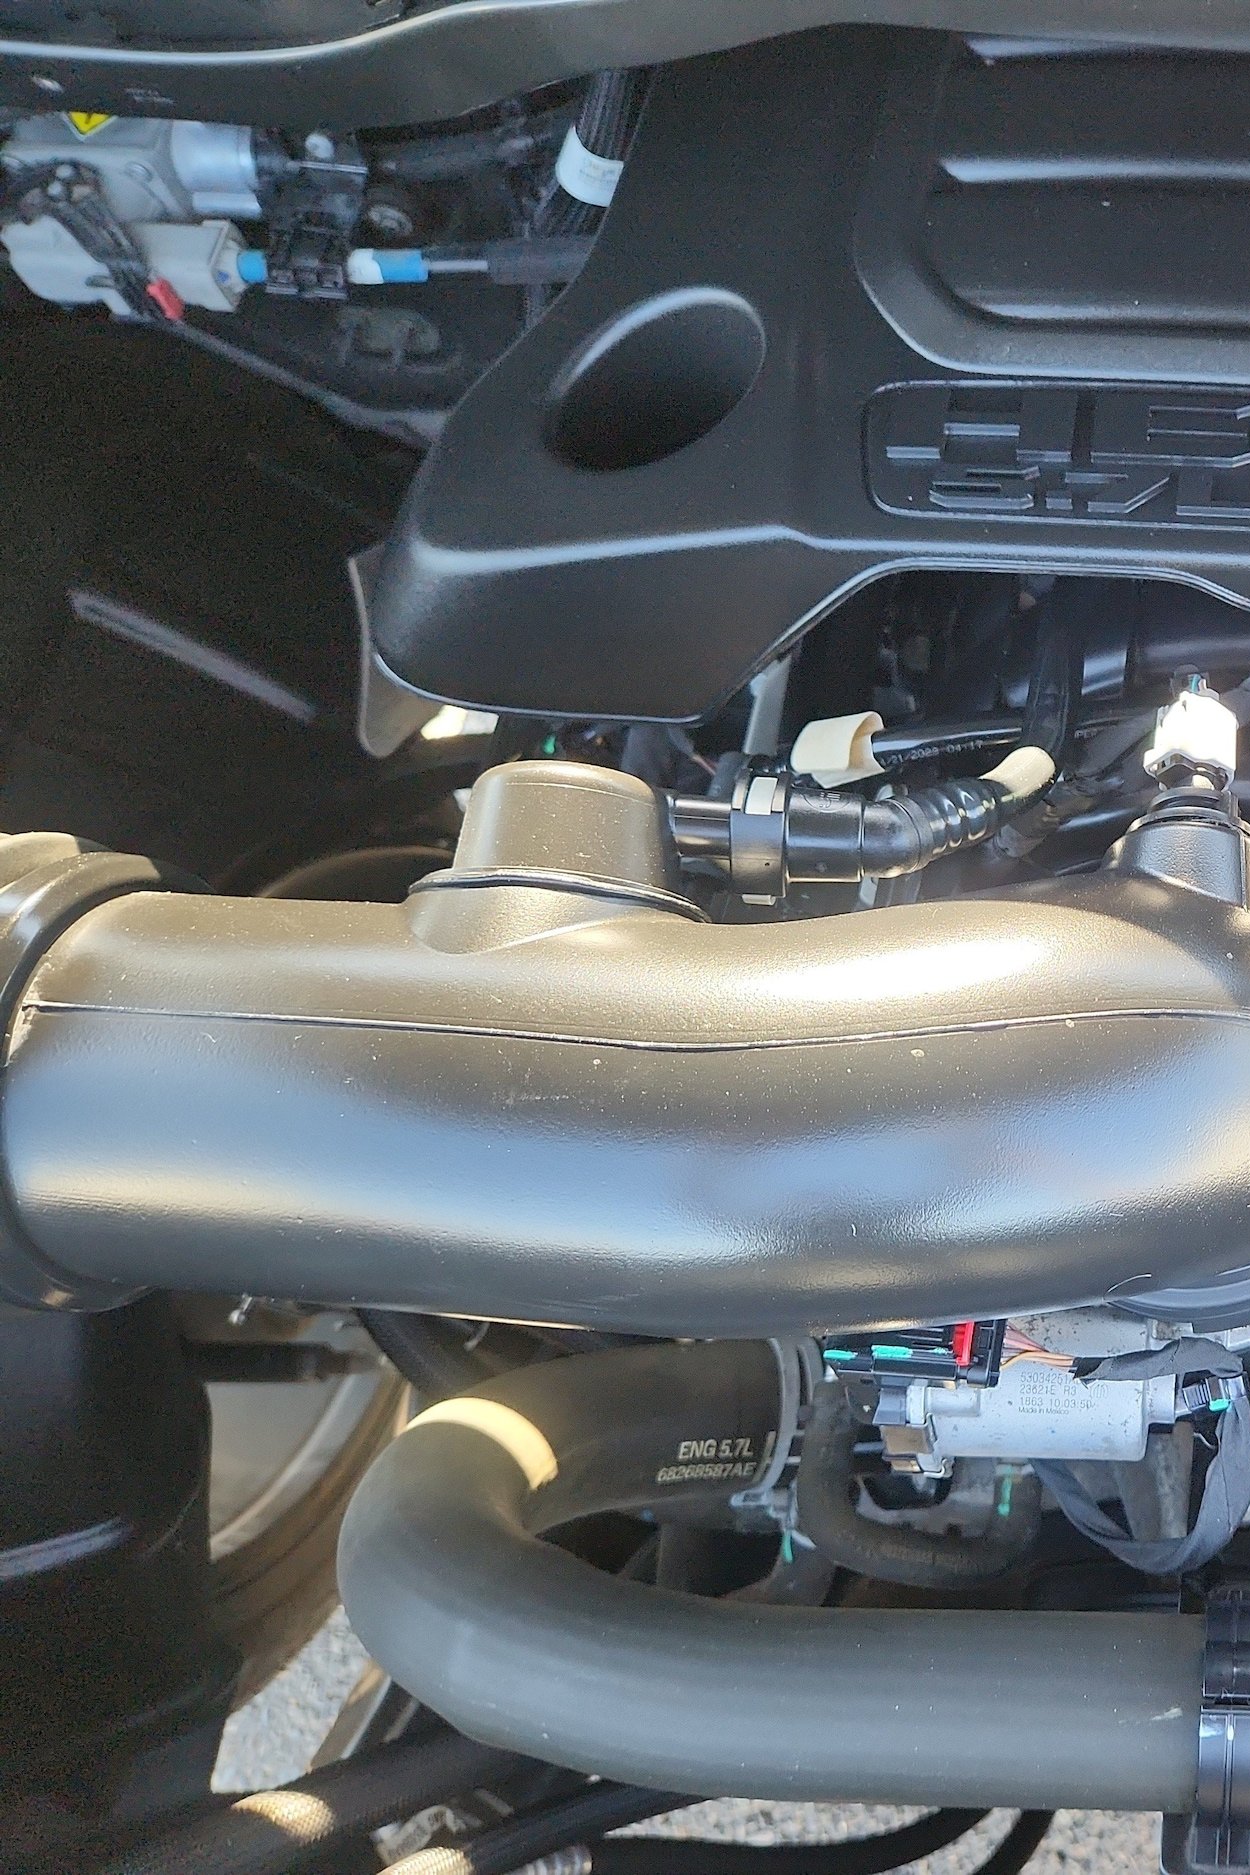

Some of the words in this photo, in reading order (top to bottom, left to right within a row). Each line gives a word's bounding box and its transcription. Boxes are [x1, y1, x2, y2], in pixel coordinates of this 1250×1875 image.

[1018, 1406, 1037, 1414] Made
[1046, 1407, 1069, 1415] Mexico
[678, 1438, 716, 1460] ENG
[719, 1437, 755, 1458] 5.7L
